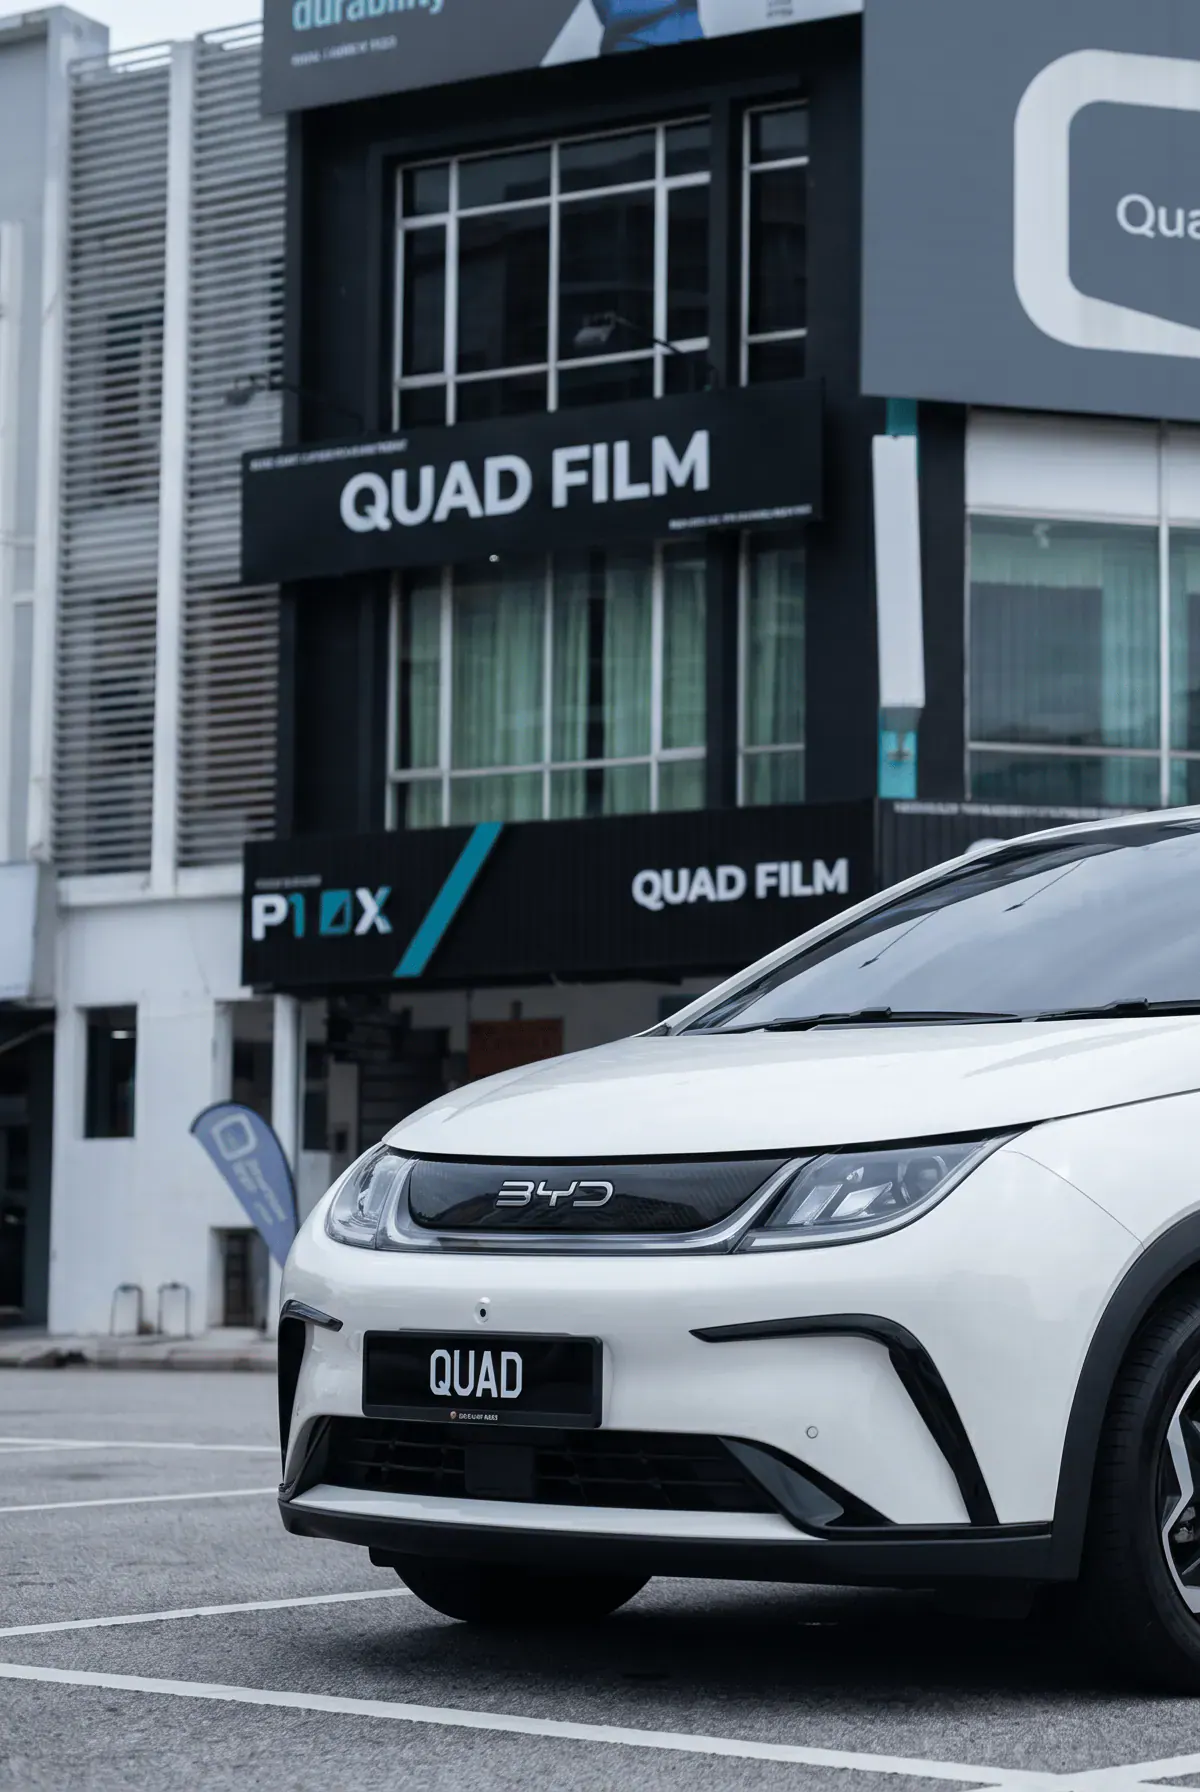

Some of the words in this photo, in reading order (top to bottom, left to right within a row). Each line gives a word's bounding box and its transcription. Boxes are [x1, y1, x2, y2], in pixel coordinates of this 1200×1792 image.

[291, 0, 445, 31] duraby
[339, 454, 533, 533] QUAD
[551, 429, 710, 509] FILM
[631, 864, 747, 912] QUAD
[755, 857, 849, 900] FILM
[495, 1180, 614, 1207] BYD
[429, 1349, 523, 1399] QUAD
